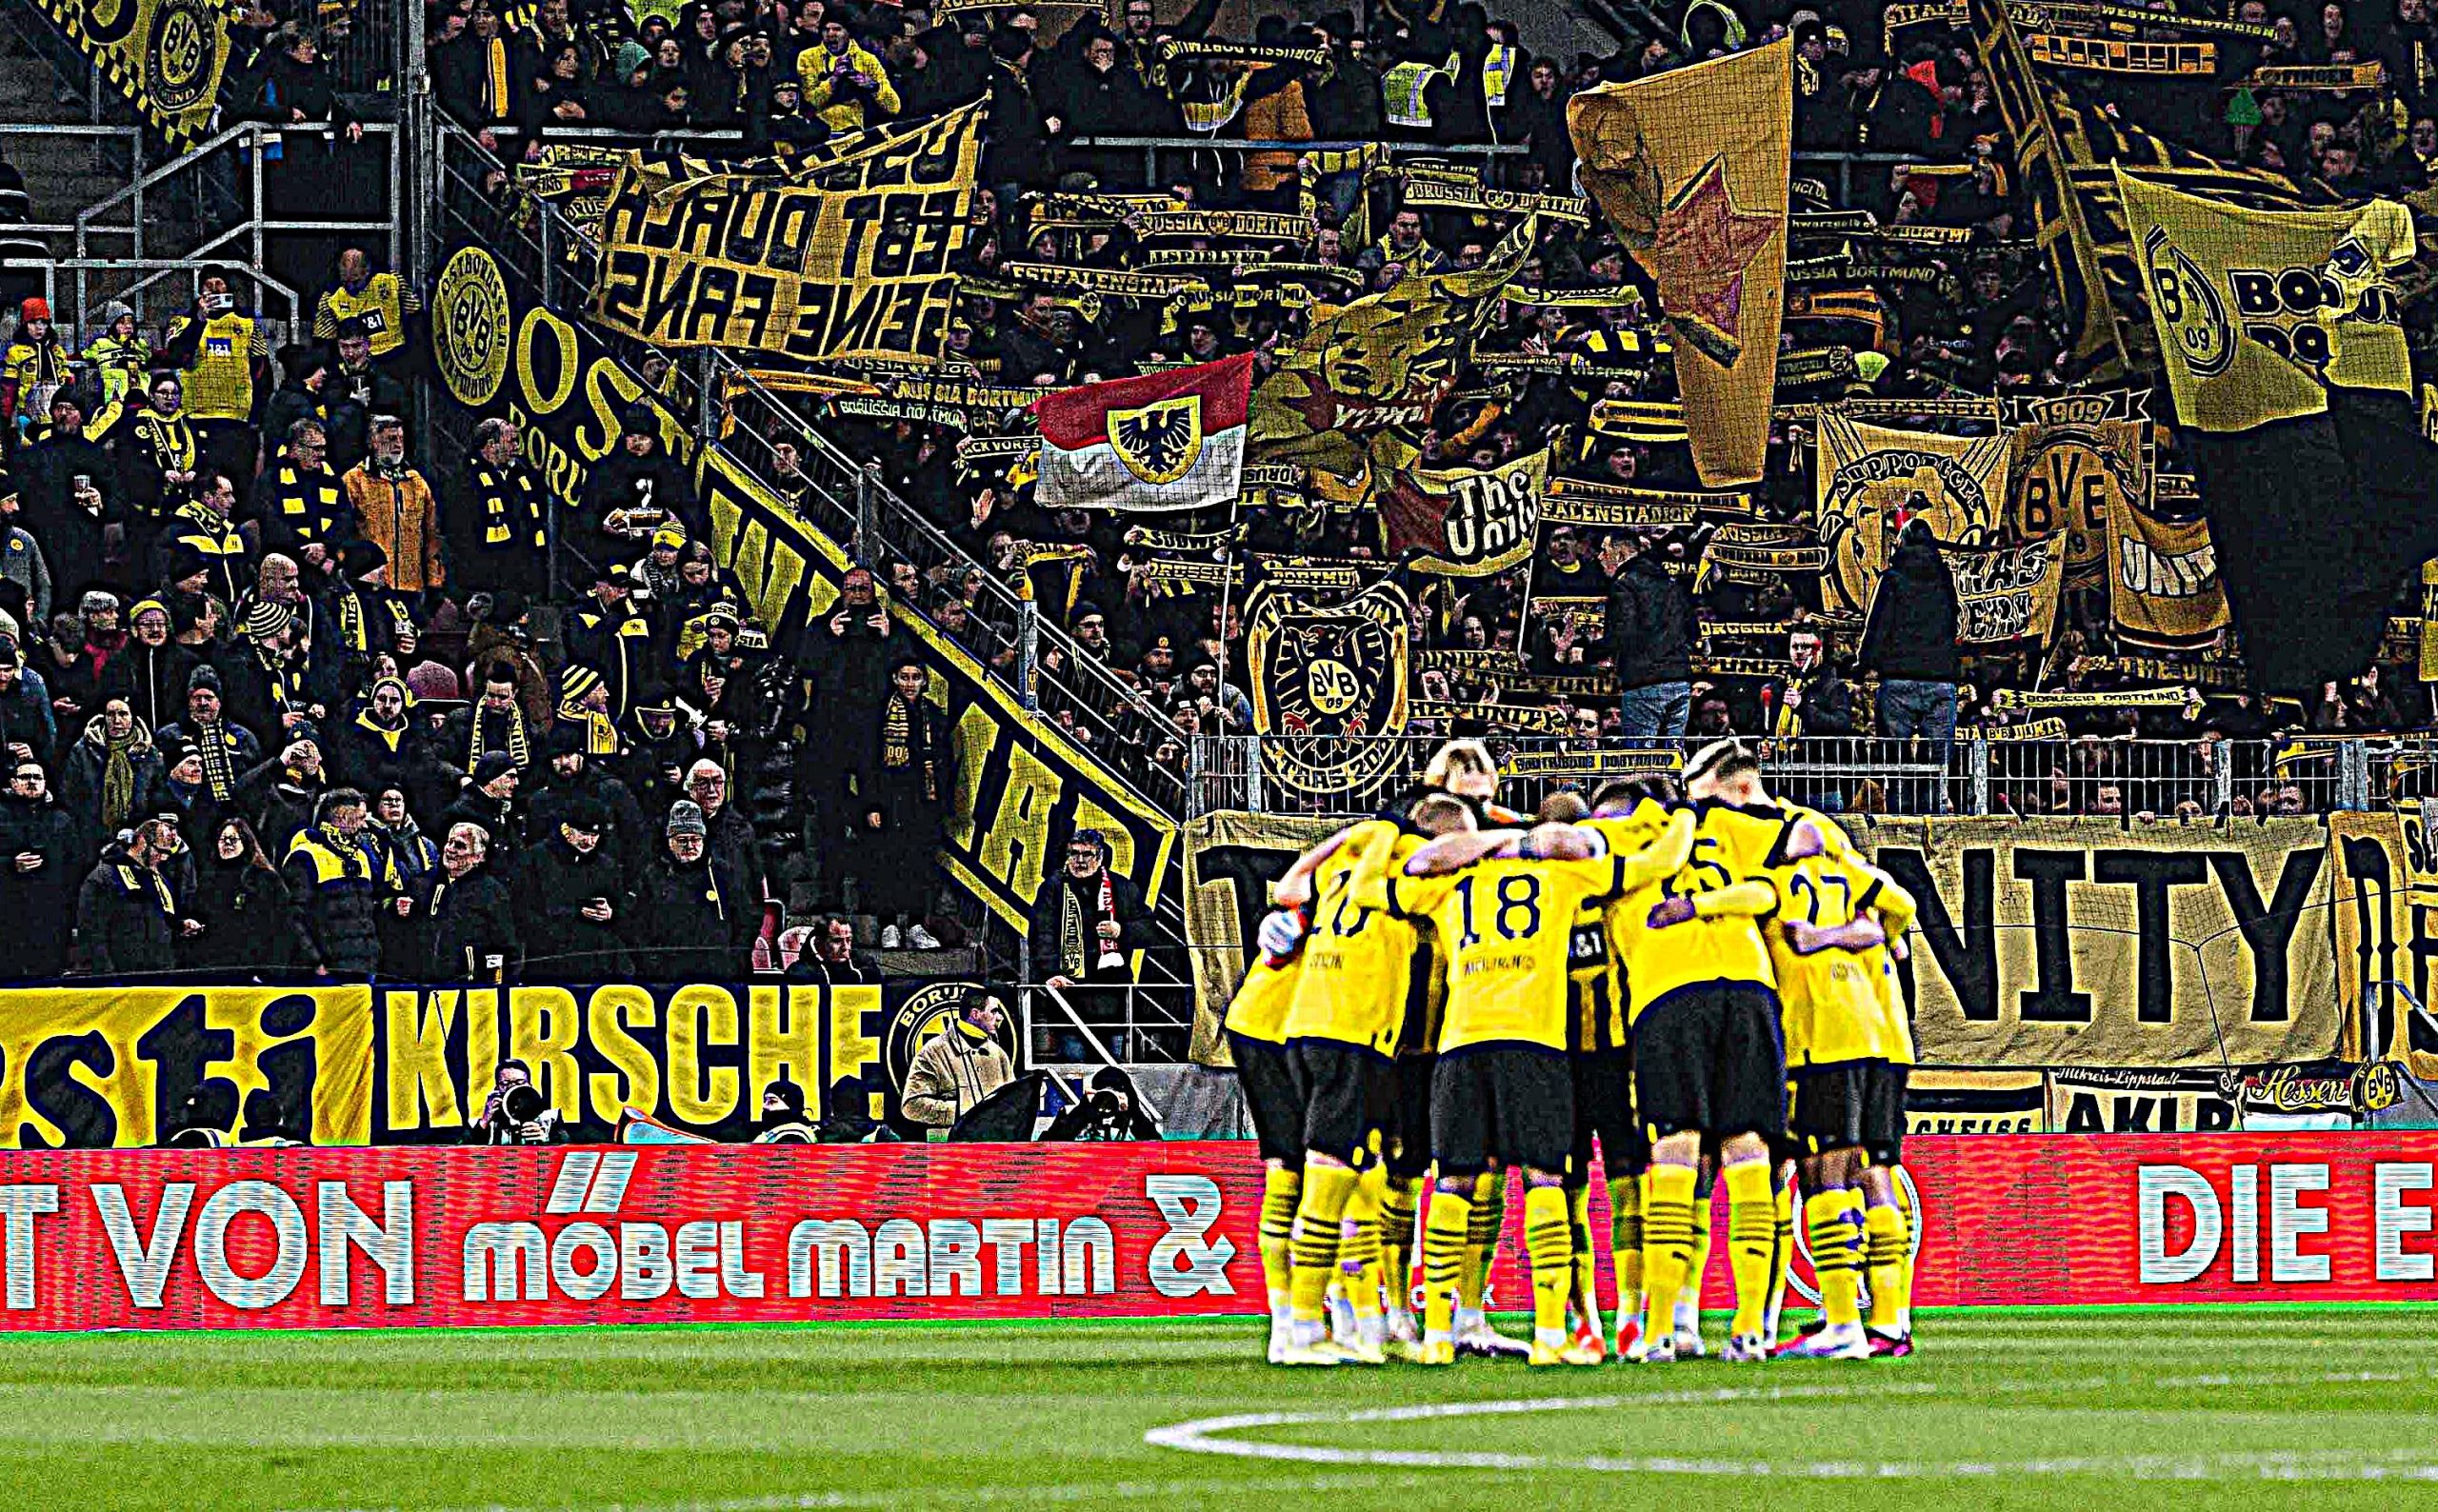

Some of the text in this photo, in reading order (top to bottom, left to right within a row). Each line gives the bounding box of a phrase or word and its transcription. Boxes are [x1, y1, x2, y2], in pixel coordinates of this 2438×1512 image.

[453, 288, 490, 358] BVB
[2039, 399, 2103, 425] 1909
[1837, 448, 1981, 511] Supporters
[1312, 663, 1357, 697] BVB
[2103, 691, 2181, 703] DORTMUND
[1454, 873, 1541, 950] 18
[385, 984, 885, 1130] KIRSCHE
[2250, 1064, 2349, 1106] Hessen
[2368, 1066, 2394, 1100] BVB
[90, 1180, 415, 1310] VON
[789, 1218, 1115, 1299] MARTIN
[1145, 1173, 1238, 1299] &
[2138, 1164, 2332, 1284] DIE
